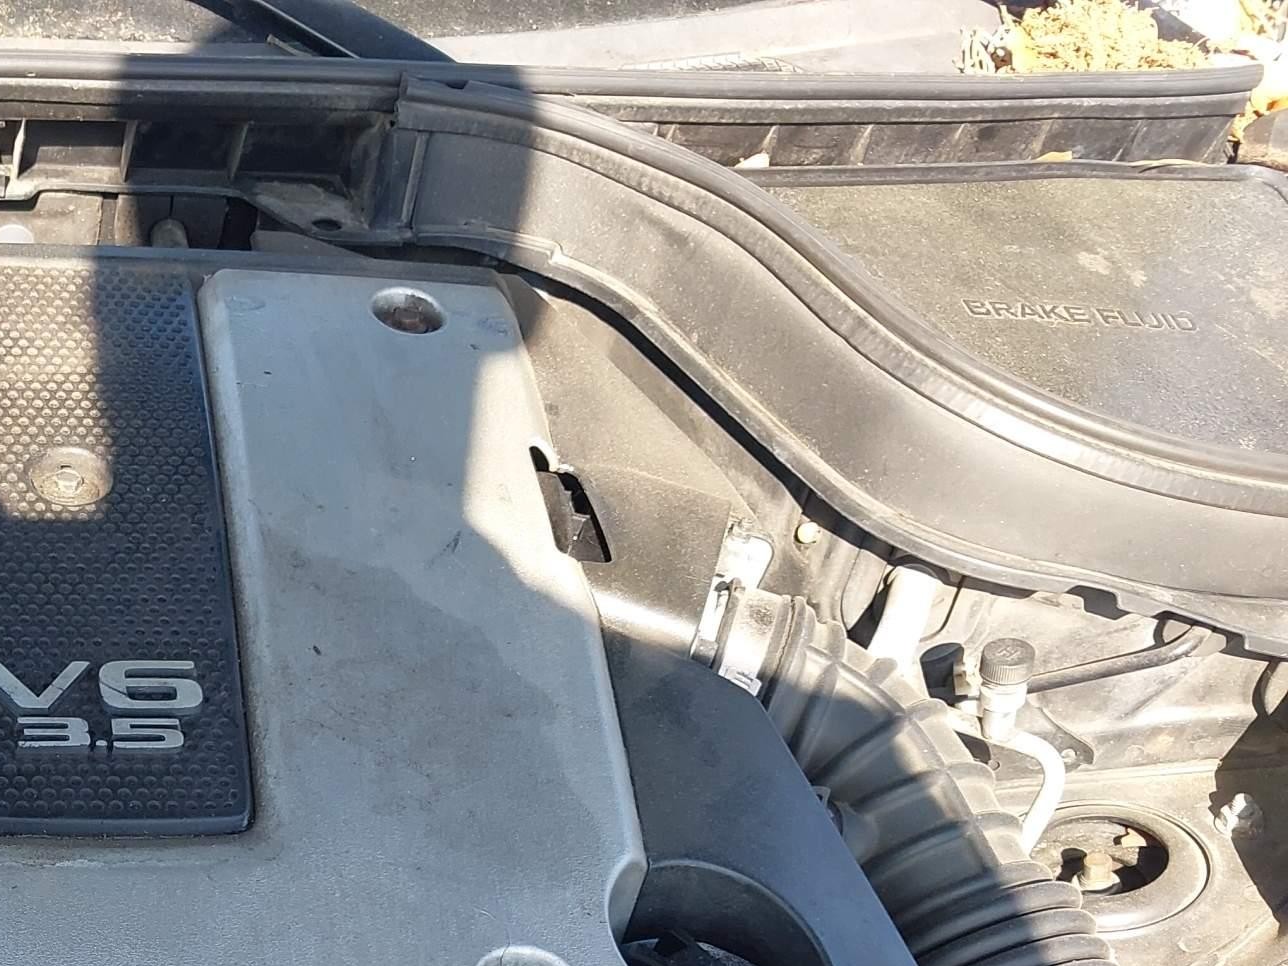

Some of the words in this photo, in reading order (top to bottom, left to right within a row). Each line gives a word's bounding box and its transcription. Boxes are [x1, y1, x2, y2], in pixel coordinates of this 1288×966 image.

[961, 298, 1093, 324] BRAKE
[1093, 306, 1199, 334] FLUID
[16, 716, 185, 750] 3.5
